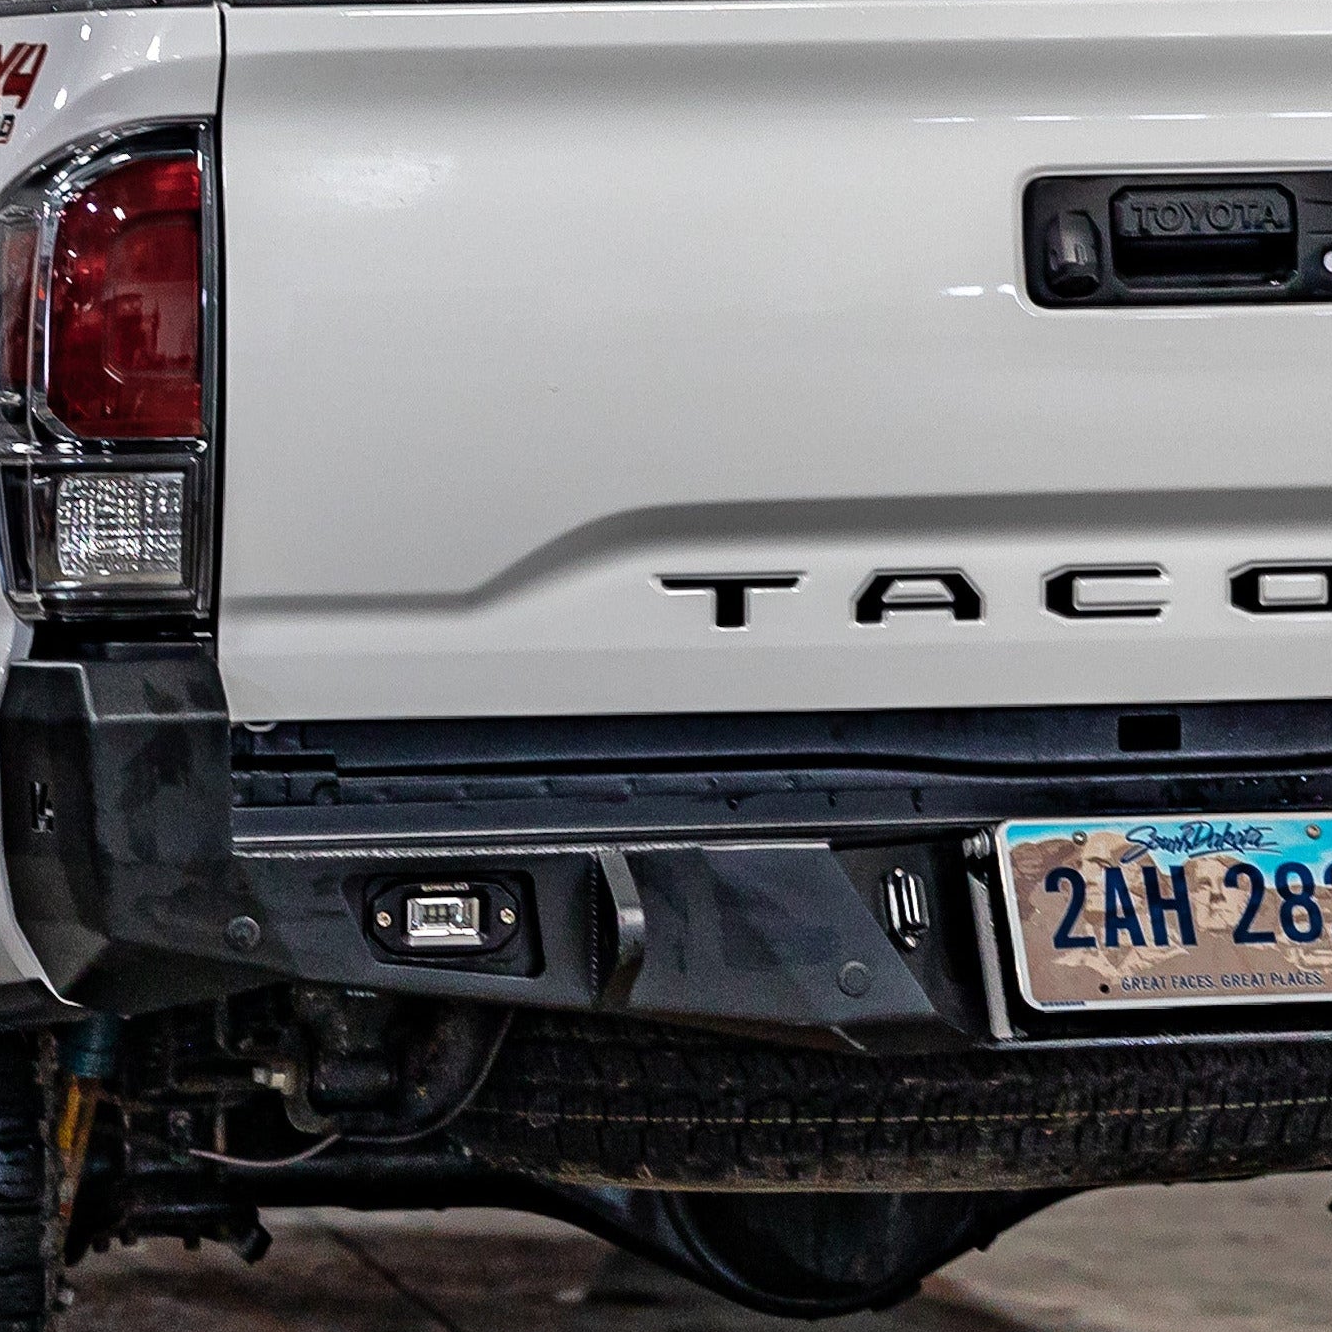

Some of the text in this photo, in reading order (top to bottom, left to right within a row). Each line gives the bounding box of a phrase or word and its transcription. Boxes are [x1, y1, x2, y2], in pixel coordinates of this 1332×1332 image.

[1131, 201, 1285, 233] TOYOTA
[1044, 865, 1198, 950] 2AH
[1121, 975, 1167, 992] GREAT
[1220, 972, 1267, 989] GREAT
